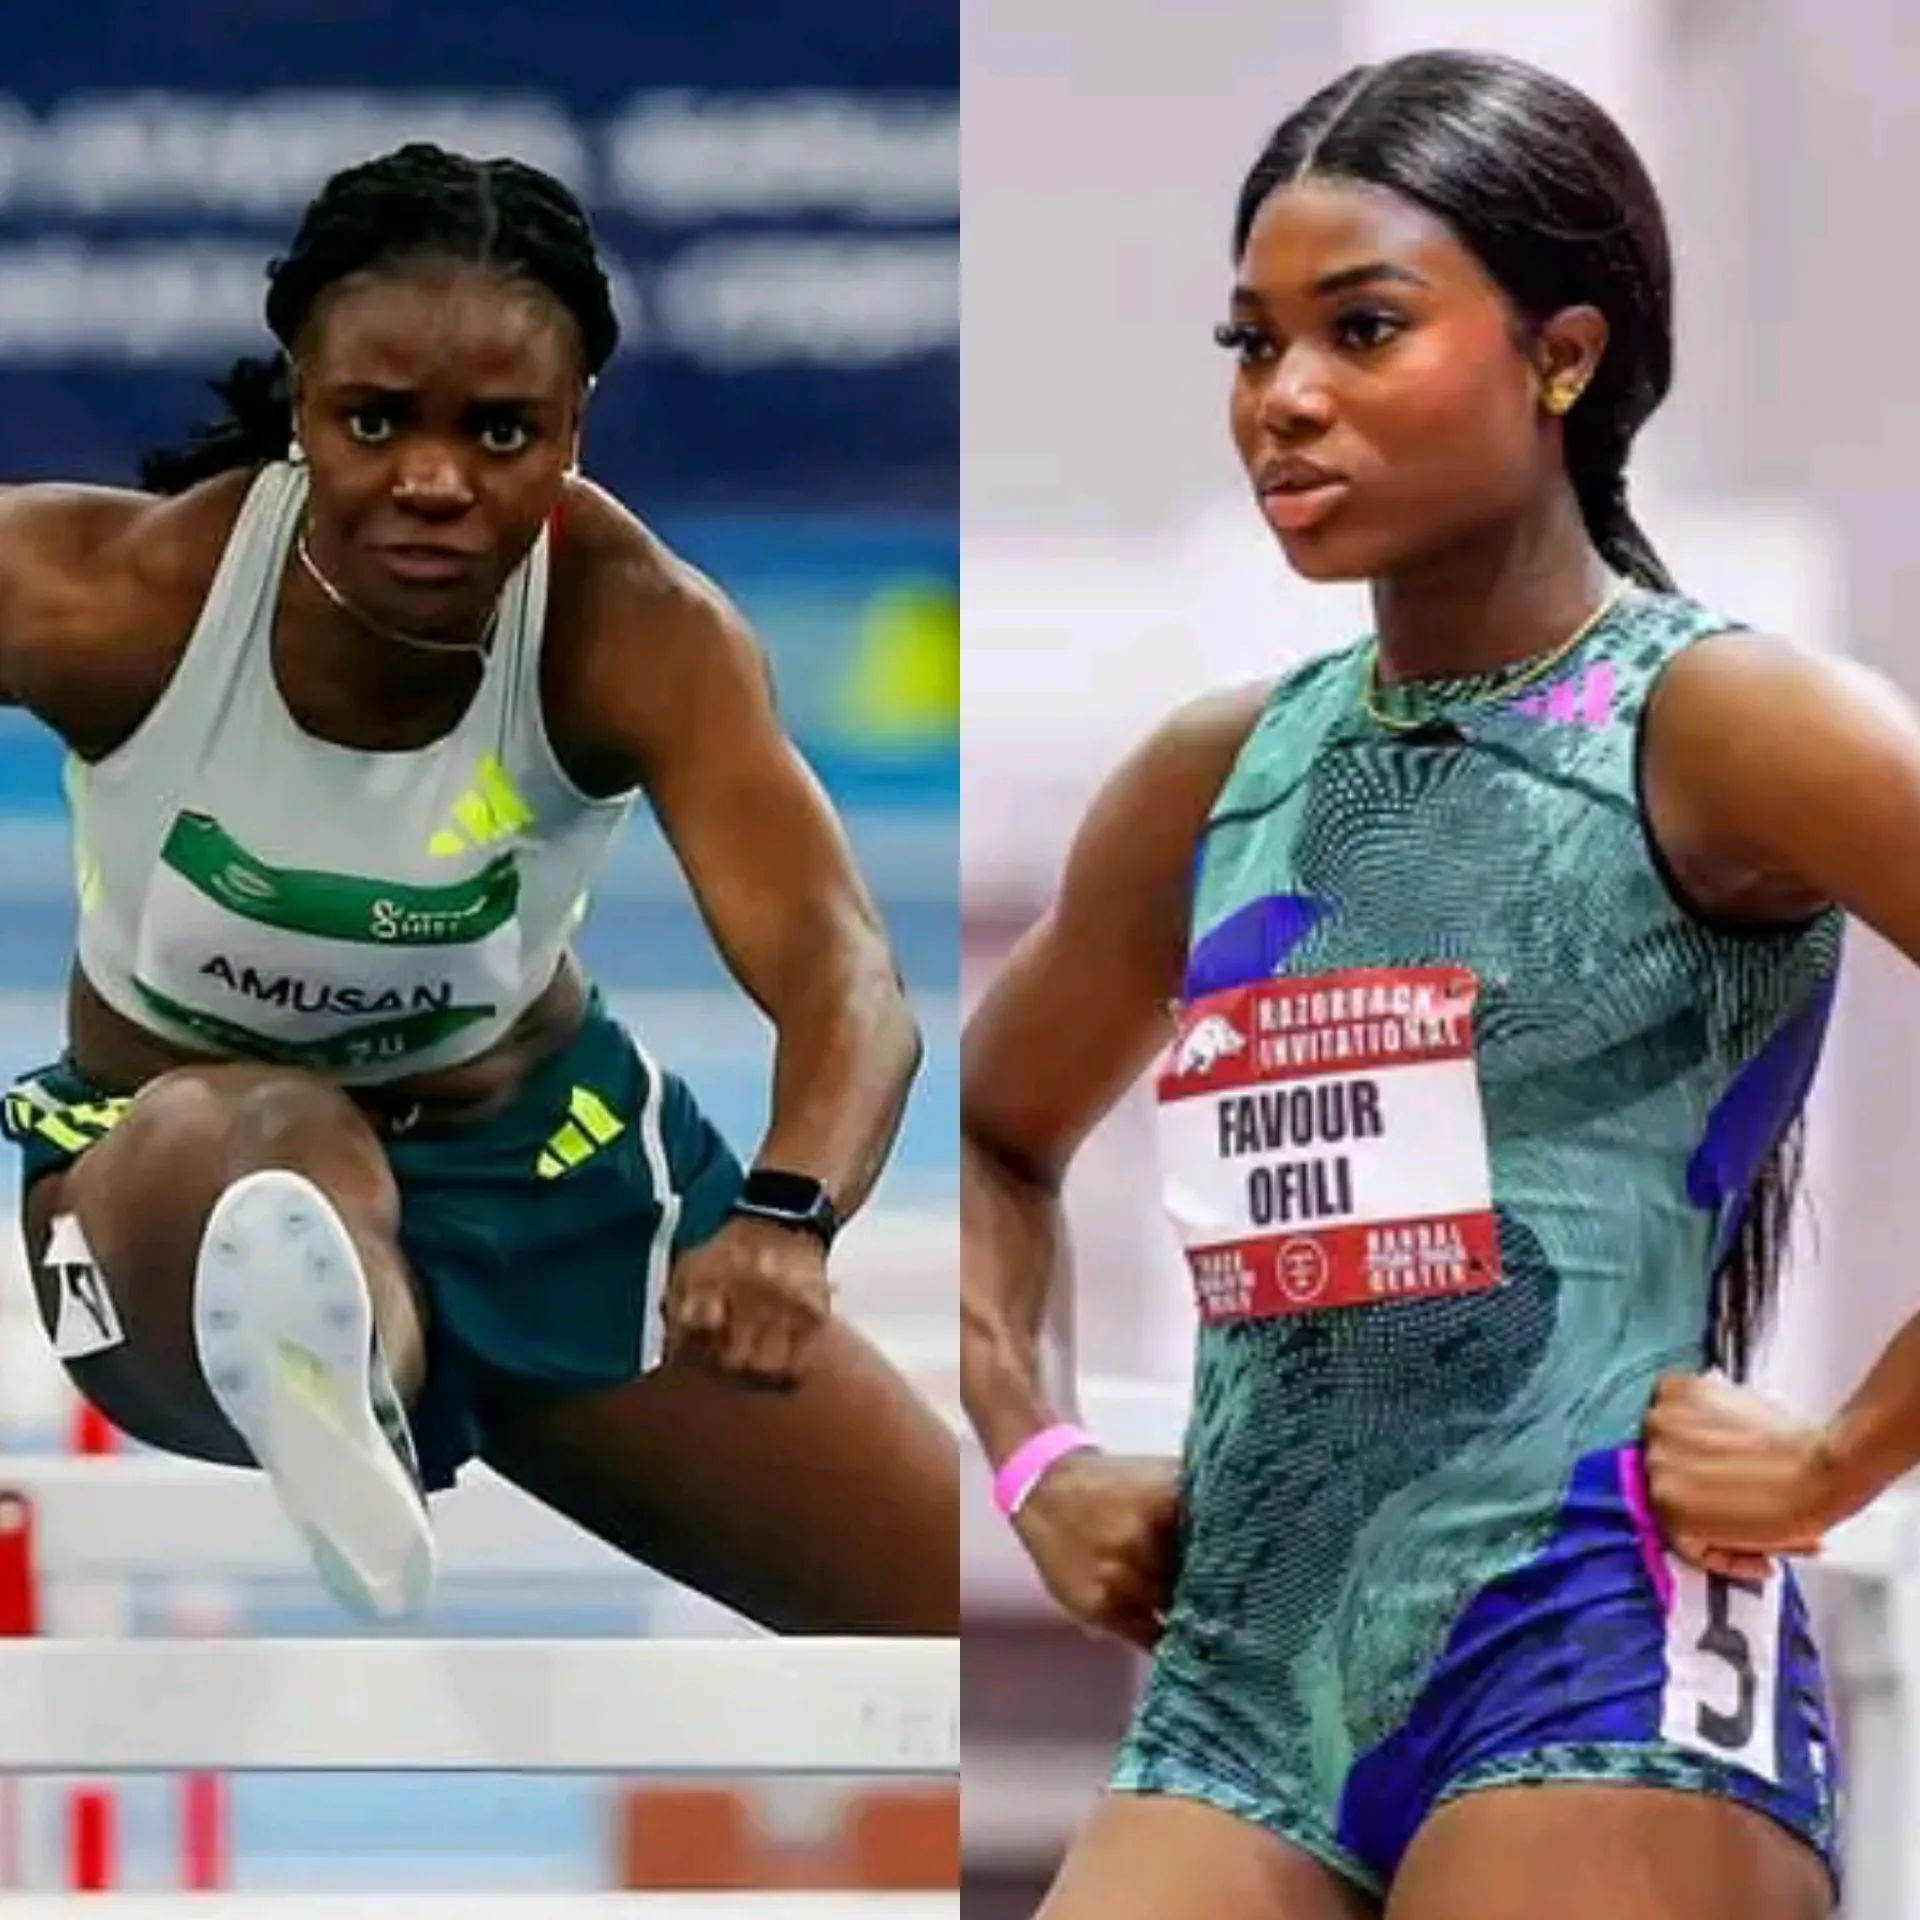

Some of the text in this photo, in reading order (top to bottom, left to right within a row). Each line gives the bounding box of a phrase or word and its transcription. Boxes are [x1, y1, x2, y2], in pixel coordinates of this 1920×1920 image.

[200, 955, 454, 1015] AMUSAN
[1218, 1079, 1384, 1158] FAVOUR
[1248, 1156, 1353, 1227] OFILI
[1696, 1571, 1764, 1749] 5
